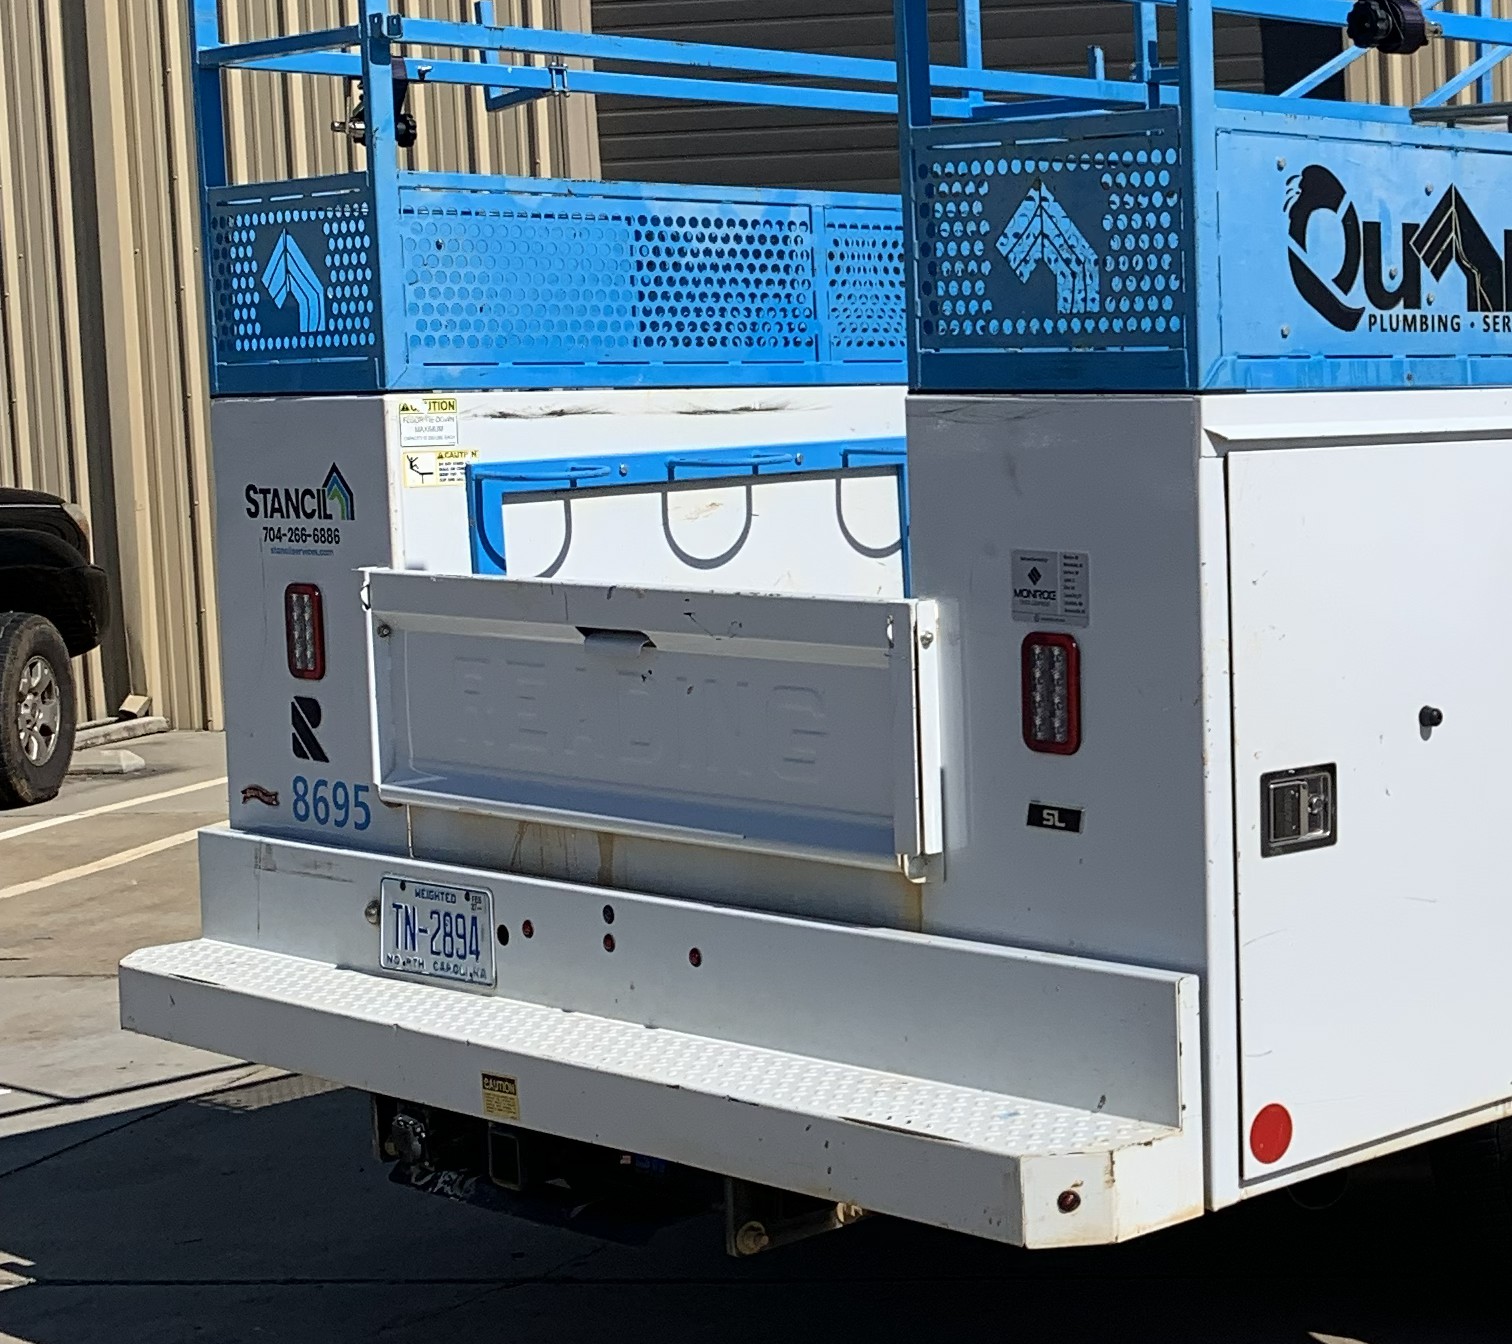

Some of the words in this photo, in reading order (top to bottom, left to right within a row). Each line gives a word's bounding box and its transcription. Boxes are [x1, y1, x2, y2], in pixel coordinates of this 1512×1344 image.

[1367, 311, 1461, 333] PLUMBING
[244, 483, 333, 520] STANCIL
[262, 526, 341, 545] 704-266-6886
[1013, 588, 1057, 601] MONROE
[292, 775, 372, 831] 8695
[1042, 808, 1066, 828] SL
[414, 888, 457, 905] WEIGHTED
[391, 902, 481, 964] TN-2894
[386, 953, 425, 969] NORTH
